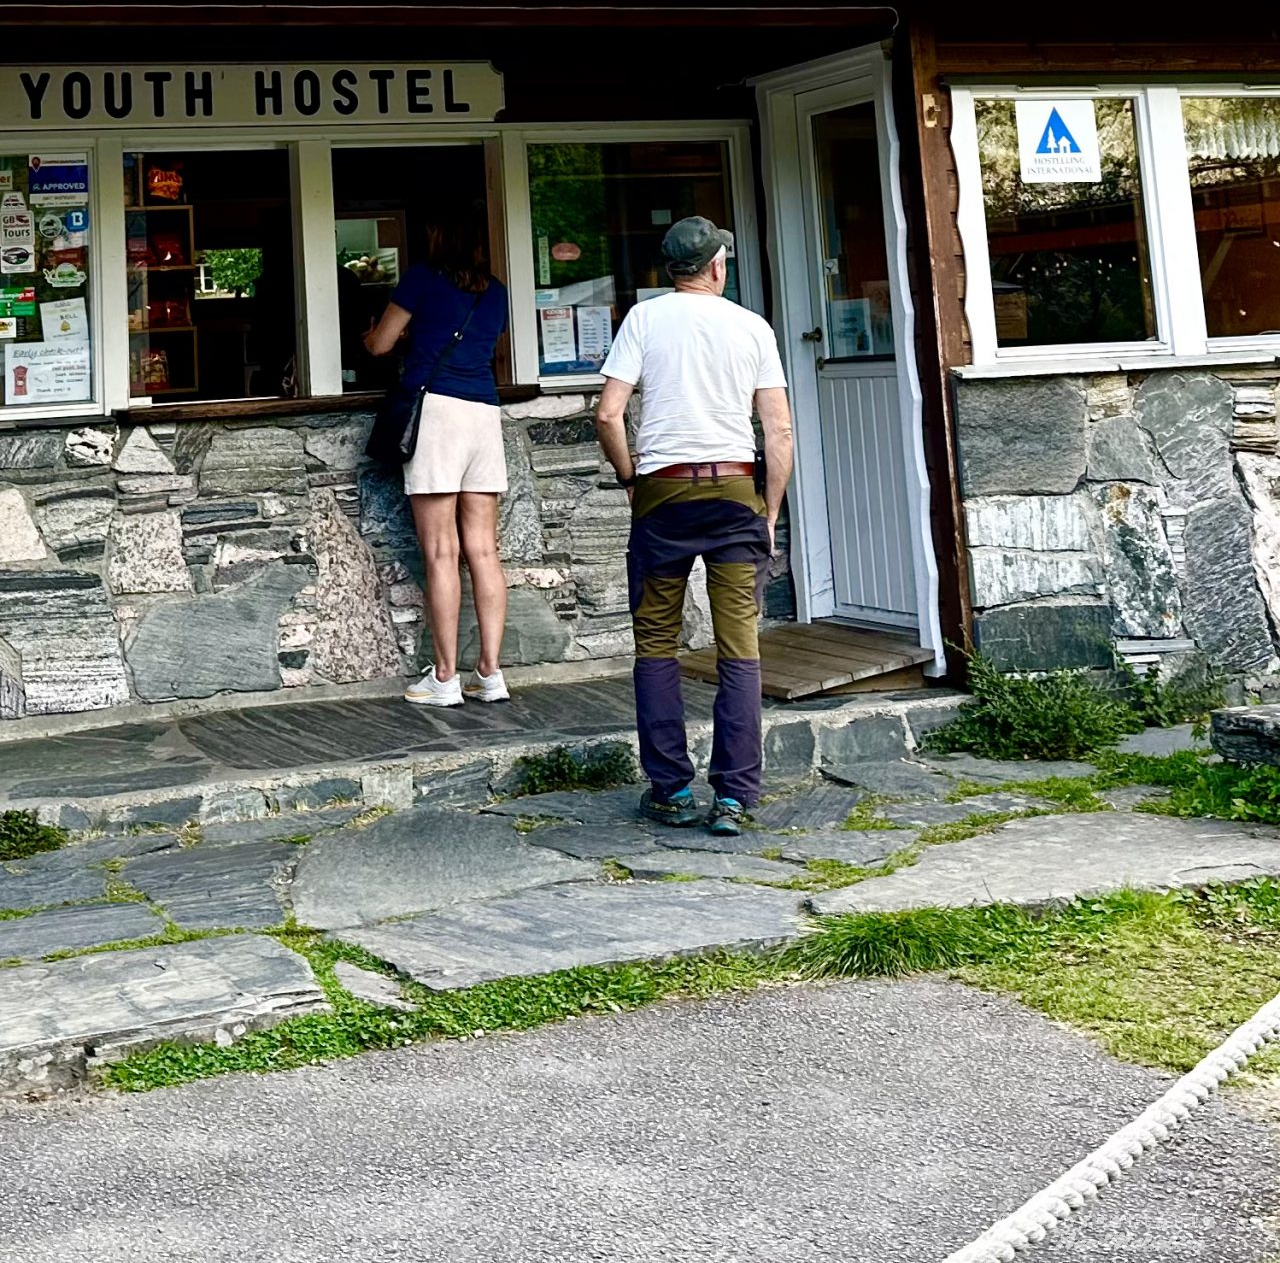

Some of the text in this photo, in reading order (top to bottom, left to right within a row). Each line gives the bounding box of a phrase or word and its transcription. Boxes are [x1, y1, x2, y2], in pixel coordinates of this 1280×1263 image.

[20, 69, 471, 120] YOUTH HOSTEL
[1034, 157, 1086, 165] HOSTELLING
[1027, 166, 1094, 175] INTERNATIONAL
[42, 183, 86, 191] APPROVED
[2, 215, 15, 225] GB
[3, 228, 31, 238] Tours
